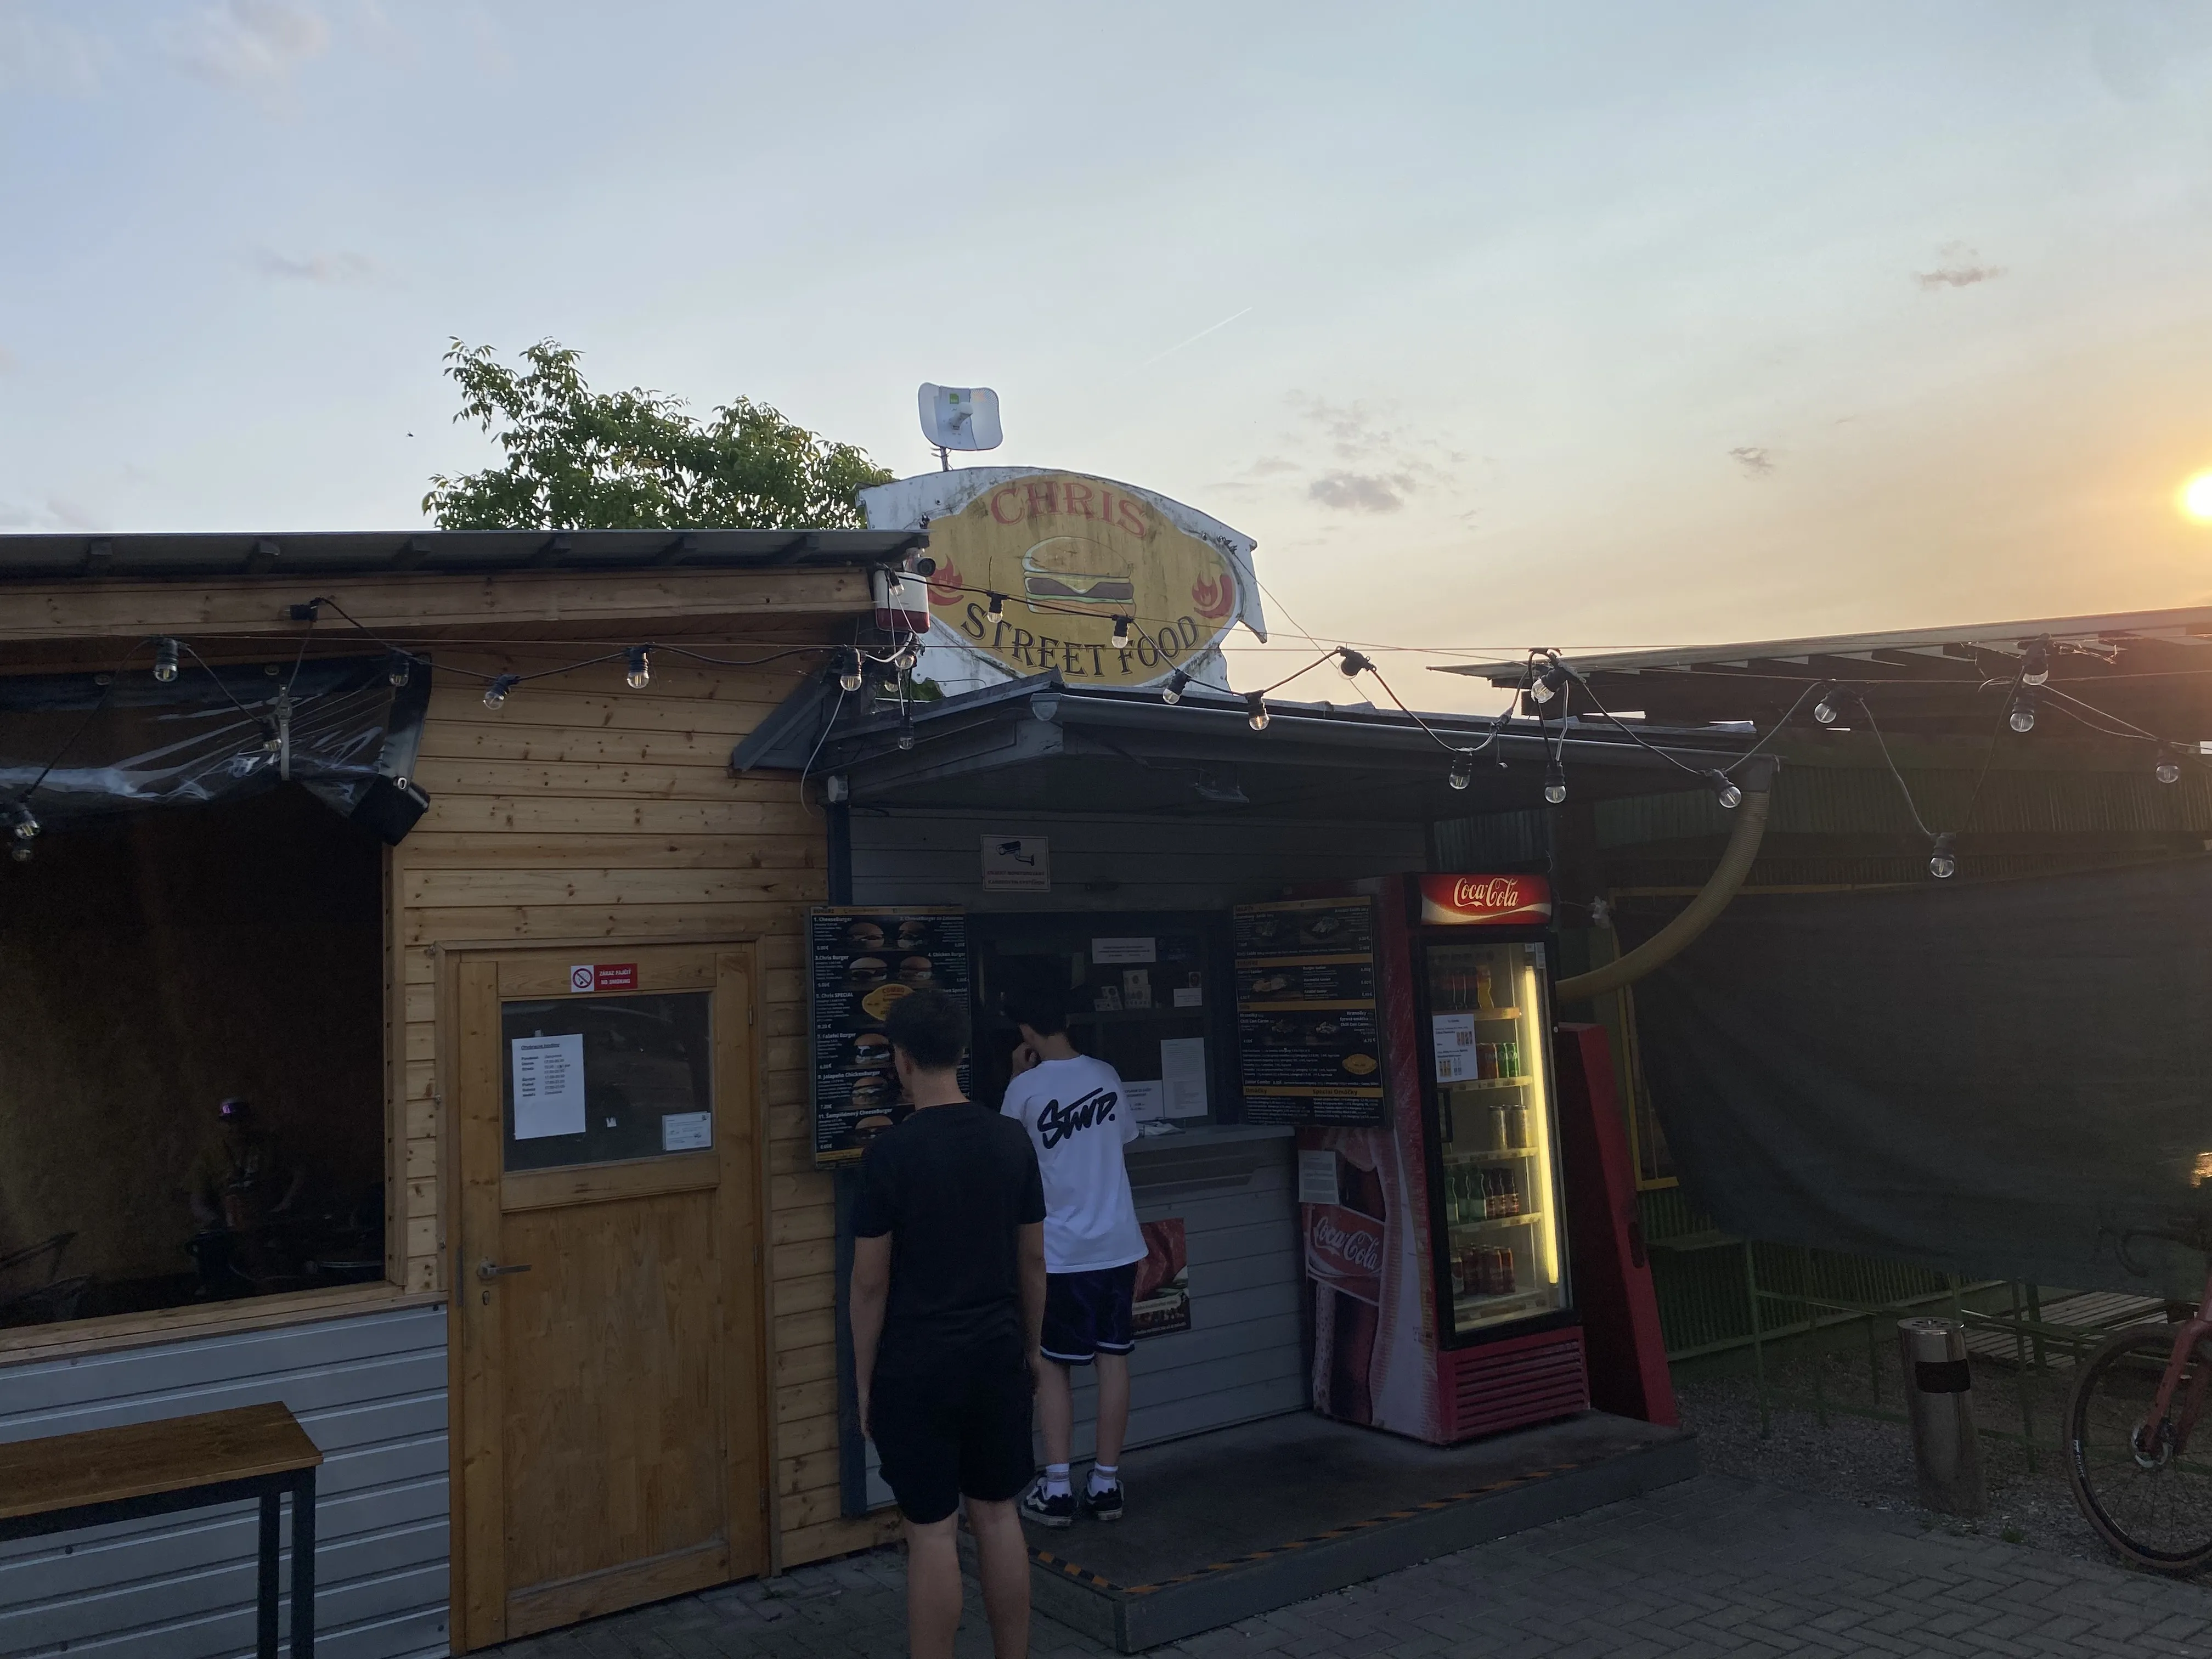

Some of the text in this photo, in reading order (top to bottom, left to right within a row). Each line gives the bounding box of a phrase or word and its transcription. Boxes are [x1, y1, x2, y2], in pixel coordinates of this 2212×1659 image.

[991, 481, 1147, 539] CHRIS
[961, 602, 1200, 677] STREET FOOD
[1453, 877, 1519, 907] Coca-Cola
[1313, 1216, 1380, 1270] Coca-Cola
